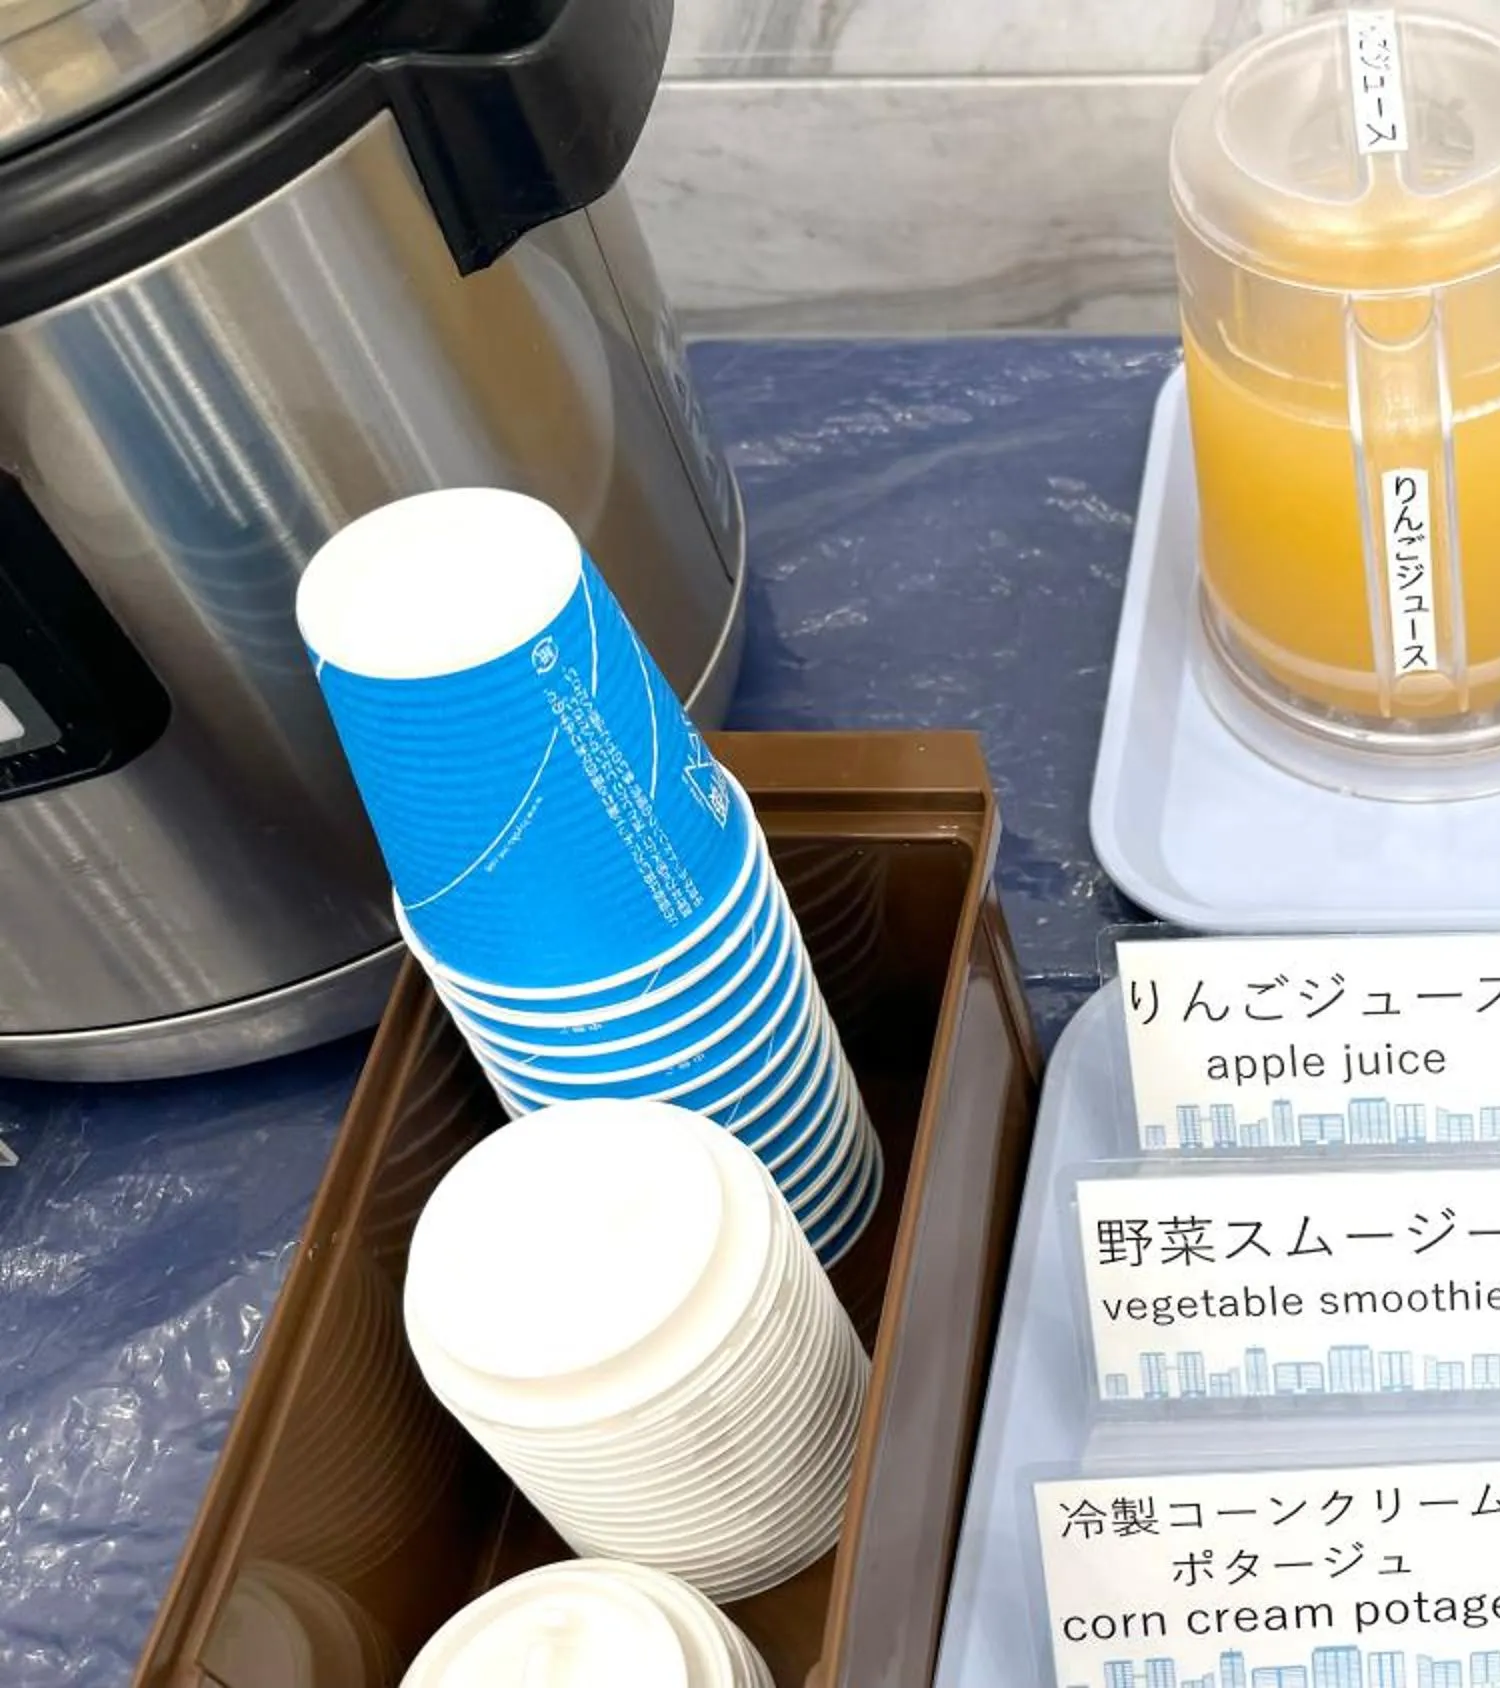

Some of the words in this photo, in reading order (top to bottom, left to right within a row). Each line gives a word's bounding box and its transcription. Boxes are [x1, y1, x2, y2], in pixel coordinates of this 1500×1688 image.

[1393, 475, 1430, 670] りんごジュース
[1206, 1042, 1326, 1088] apple
[1341, 1042, 1447, 1085] juice
[1101, 1284, 1304, 1327] vegetable
[1172, 1540, 1413, 1588] ポタージュ
[1062, 1610, 1168, 1643] corn
[1186, 1602, 1334, 1636] cream
